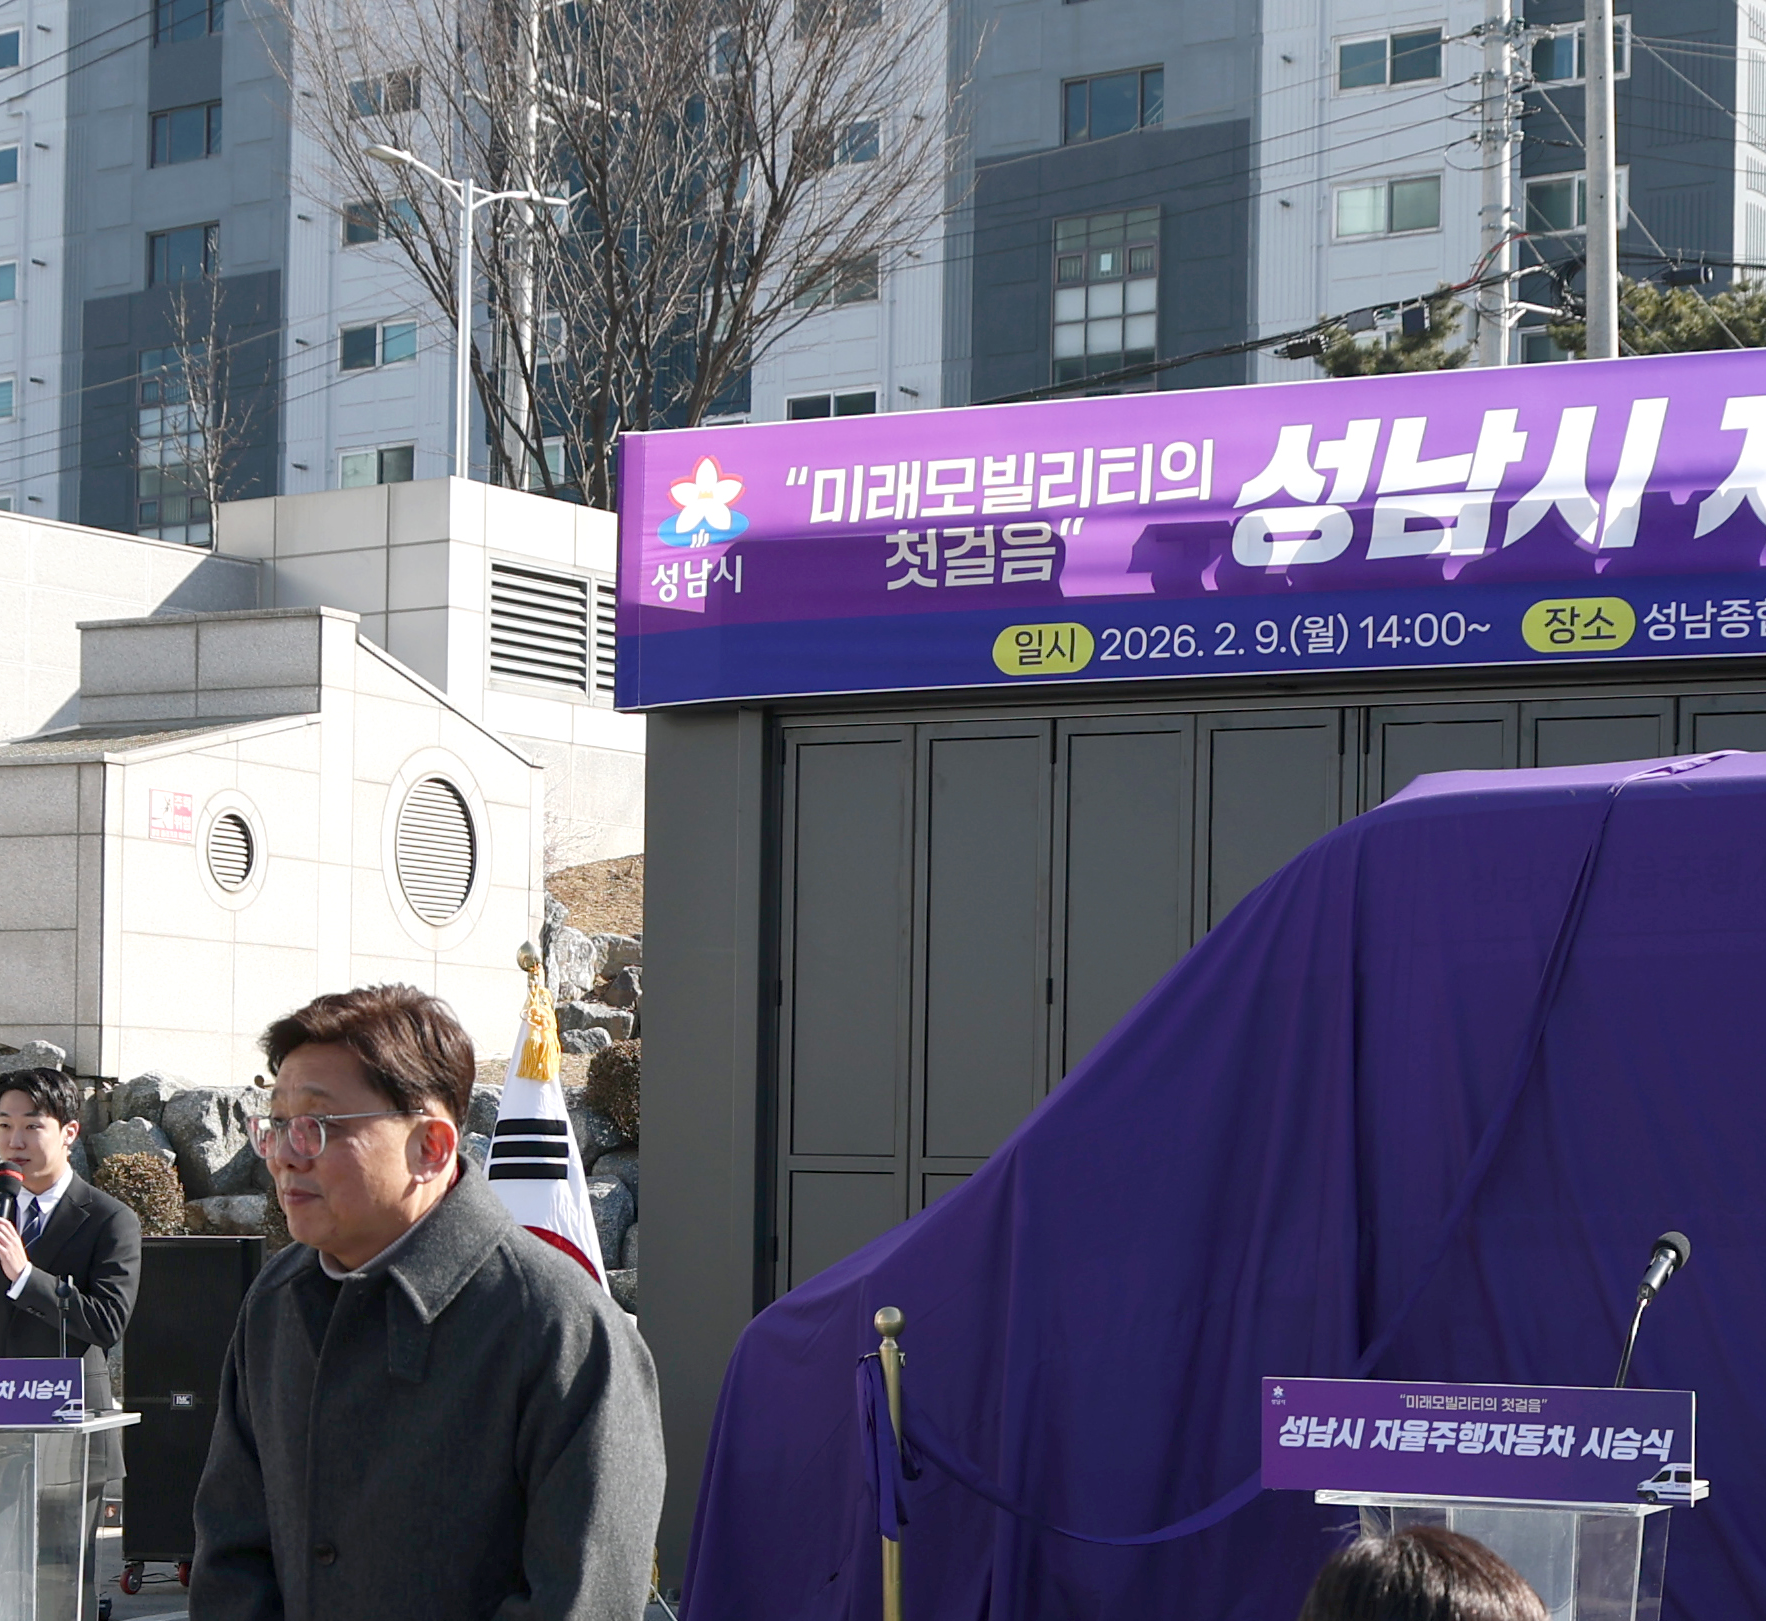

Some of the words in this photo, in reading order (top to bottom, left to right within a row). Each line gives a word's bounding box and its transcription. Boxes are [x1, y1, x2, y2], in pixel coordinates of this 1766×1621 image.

[1231, 396, 1669, 568] 성남시
[650, 556, 744, 603] 성남시
[1014, 627, 1077, 667] 일시
[1099, 626, 1204, 662] 2026.
[1213, 622, 1246, 657] 2.
[1254, 614, 1349, 658] 9.(월)
[1359, 611, 1492, 649] 14:00~
[1543, 605, 1619, 646] 장소
[19, 1379, 73, 1401] 시승식
[1278, 1415, 1366, 1450] 성남시
[1370, 1418, 1576, 1459] 자율주행자동차
[1580, 1426, 1674, 1463] 시승식
